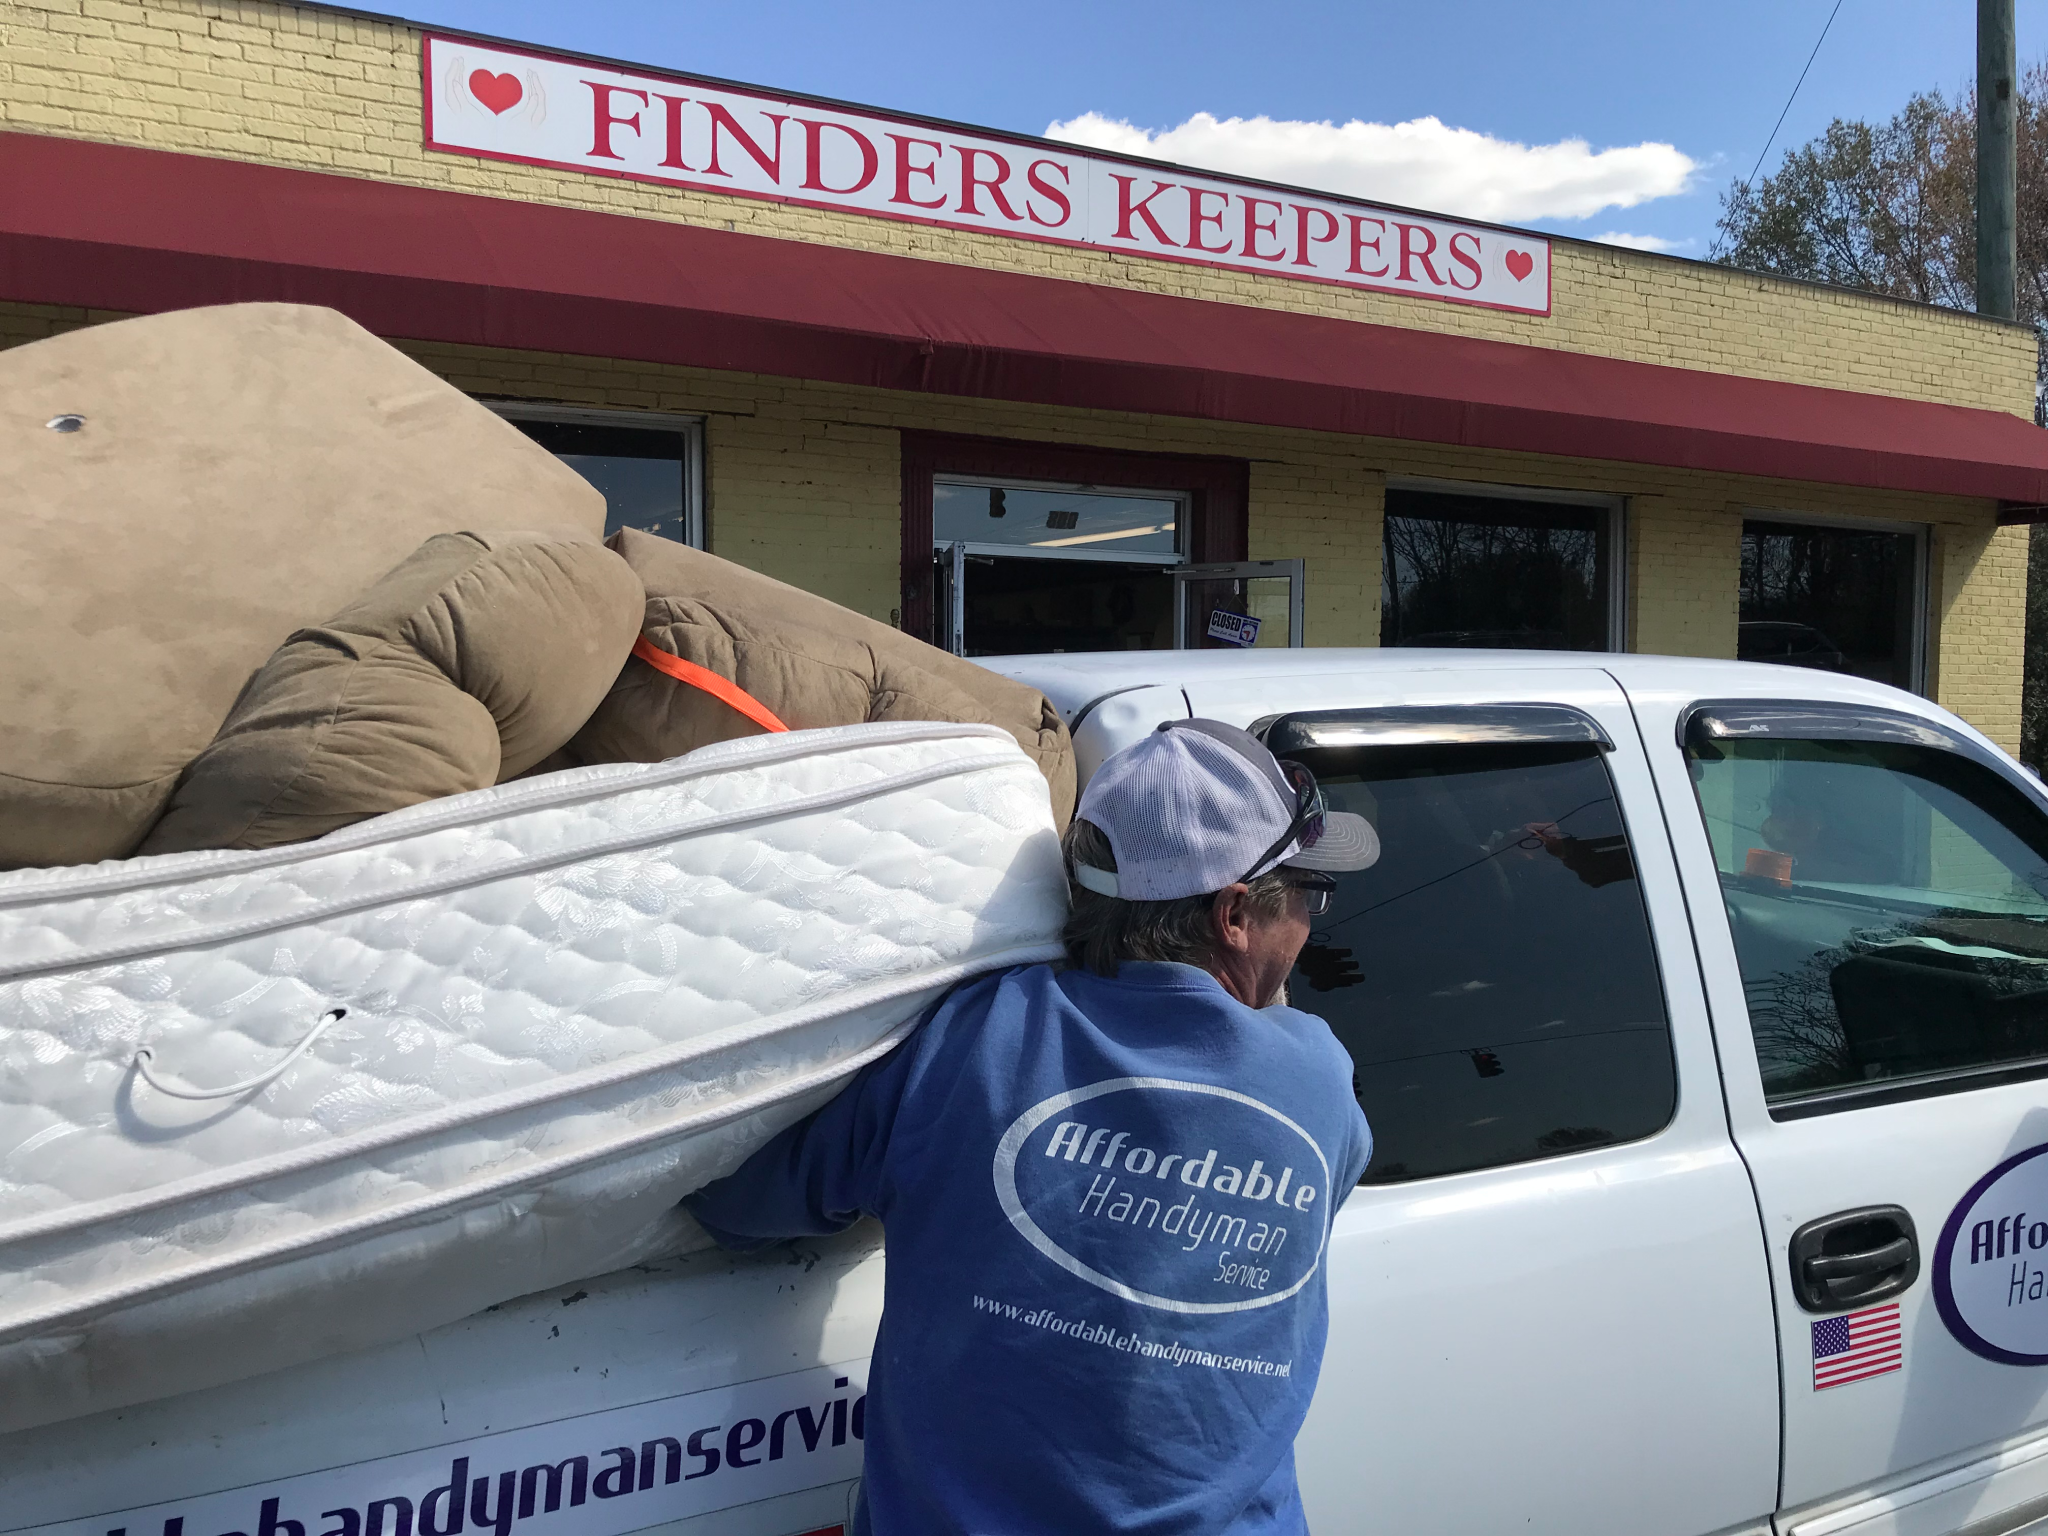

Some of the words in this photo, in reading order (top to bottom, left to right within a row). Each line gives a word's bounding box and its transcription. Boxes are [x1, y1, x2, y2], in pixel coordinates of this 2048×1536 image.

[579, 79, 1071, 228] FINDERS
[1107, 172, 1483, 292] KEEPERS
[1212, 611, 1242, 631] CLOSED
[1044, 1121, 1317, 1213] Affordable
[1078, 1173, 1288, 1256] Handyman
[1213, 1251, 1271, 1291] Service
[2007, 1260, 2048, 1308] Ha
[972, 1294, 1293, 1378] www.affordablehandymanservice.net
